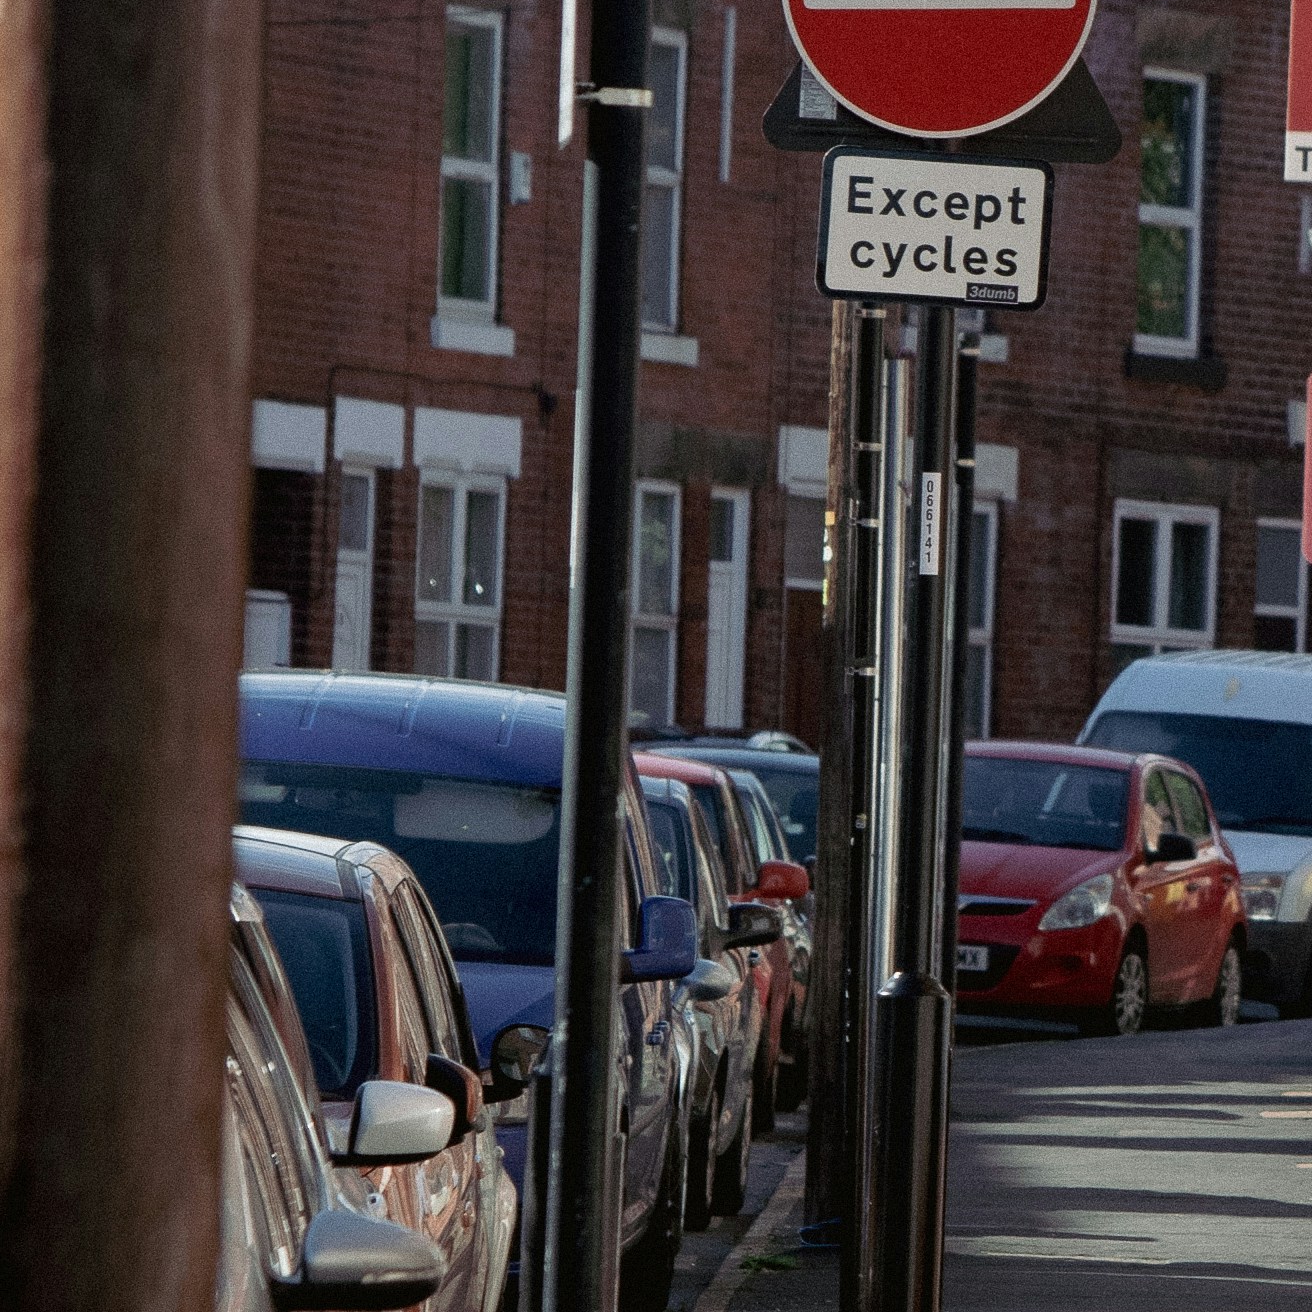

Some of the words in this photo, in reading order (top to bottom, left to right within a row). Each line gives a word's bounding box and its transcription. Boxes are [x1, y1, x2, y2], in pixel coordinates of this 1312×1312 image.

[847, 175, 1027, 230] Except
[850, 235, 1018, 278] cycles
[969, 285, 1016, 300] 3dumb
[925, 480, 934, 563] 066141
